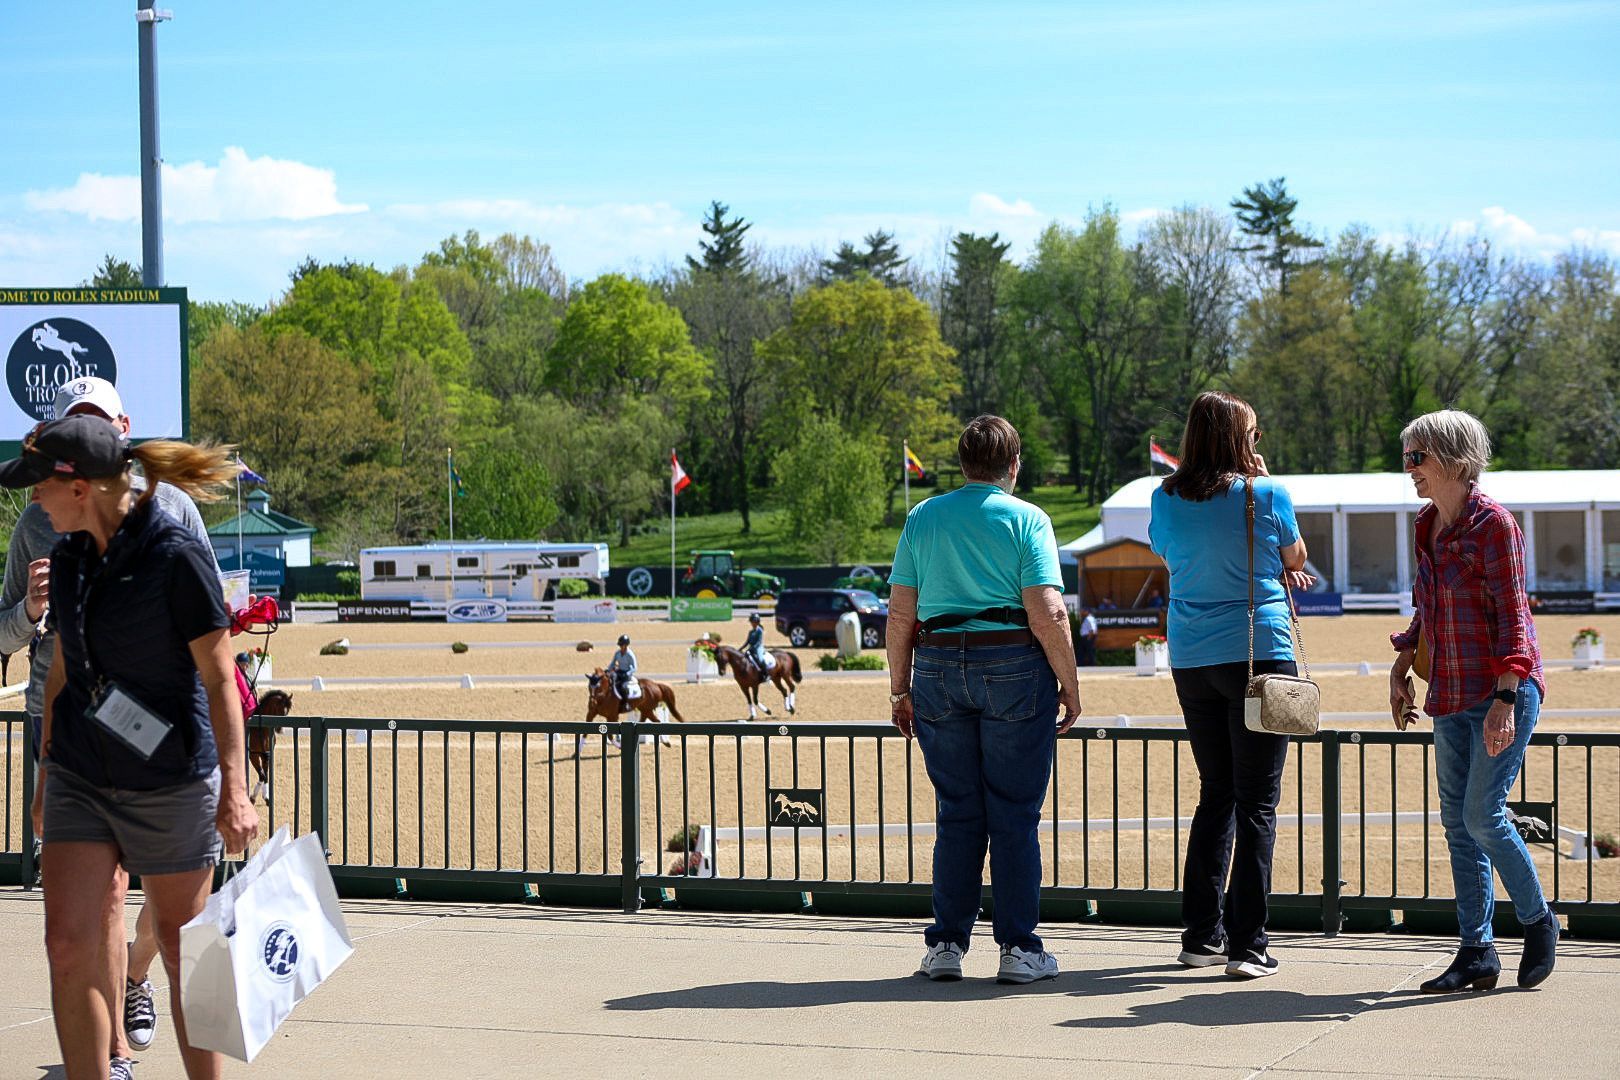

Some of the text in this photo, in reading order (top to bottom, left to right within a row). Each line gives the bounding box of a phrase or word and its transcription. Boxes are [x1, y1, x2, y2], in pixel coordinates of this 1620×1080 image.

[31, 291, 49, 302] TO
[53, 290, 97, 302] ROLEX
[101, 290, 160, 301] STADIUM
[252, 569, 280, 577] Johnson
[338, 606, 410, 615] DEFENDER
[1096, 616, 1158, 625] DEFENDER
